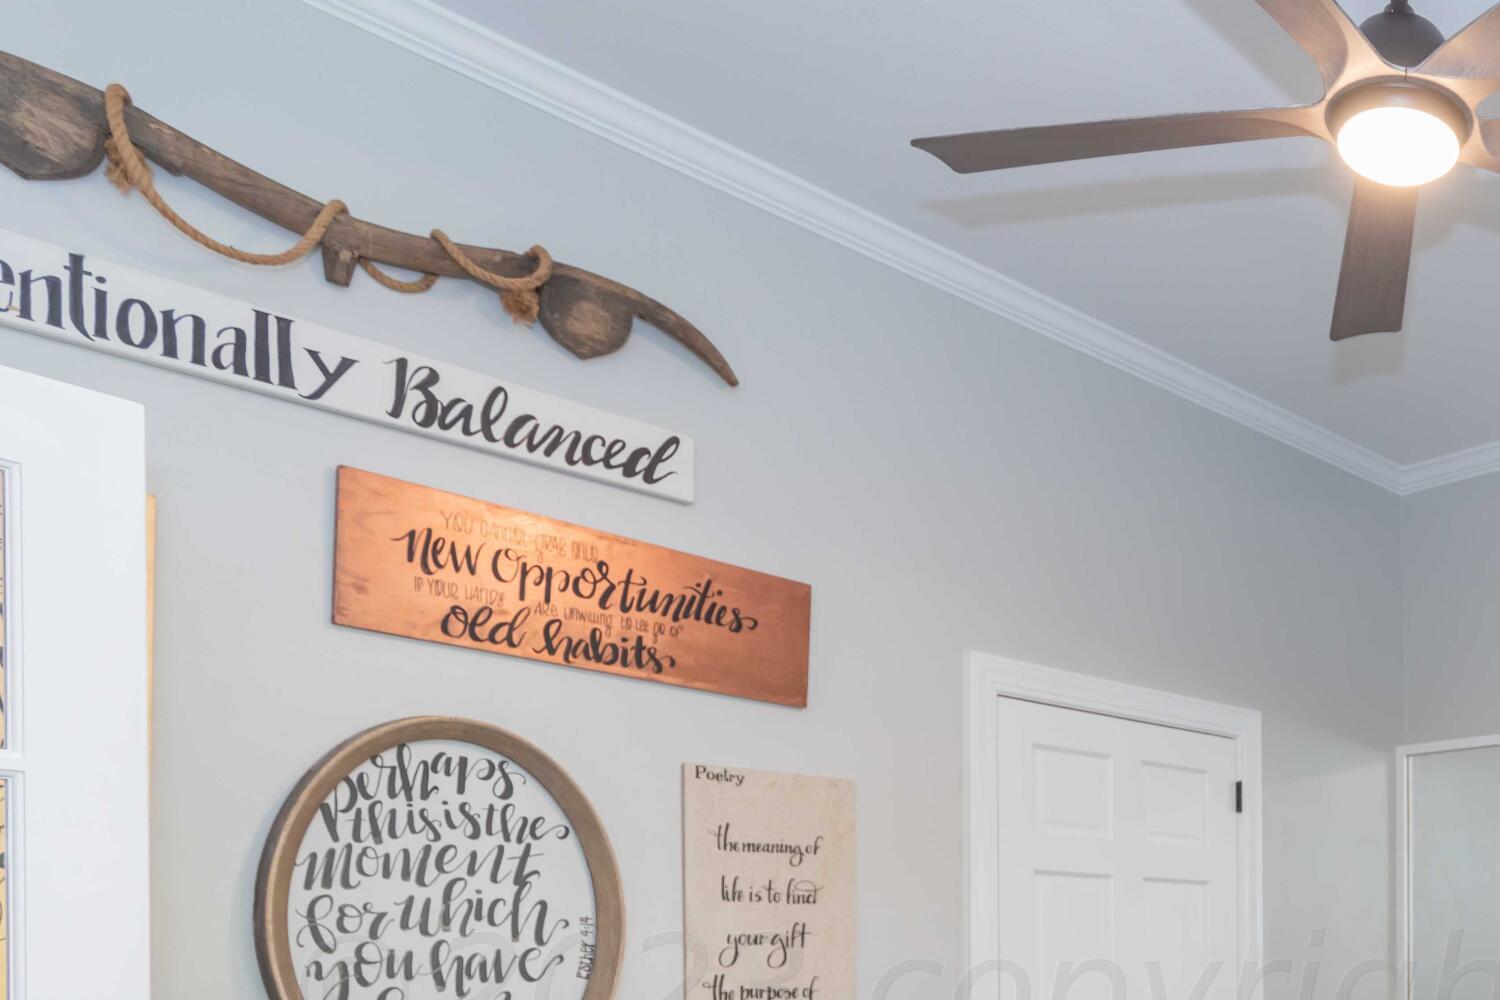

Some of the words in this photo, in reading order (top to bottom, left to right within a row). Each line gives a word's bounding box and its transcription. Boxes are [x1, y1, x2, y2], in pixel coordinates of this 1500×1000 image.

[382, 356, 681, 485] Balanced
[440, 510, 474, 535] YOU
[427, 577, 460, 601] YOUR
[695, 764, 745, 787] Poetry
[345, 800, 442, 845] this
[442, 799, 481, 840] is
[481, 802, 570, 844] the
[707, 822, 740, 853] the
[742, 838, 805, 868] meaning
[805, 835, 824, 856] of
[721, 874, 744, 902] life
[748, 886, 762, 903] is
[762, 879, 782, 904] to
[786, 877, 825, 905] find
[295, 894, 396, 955] for
[393, 876, 570, 947] which
[718, 933, 770, 969] your
[766, 922, 812, 969] gift
[422, 939, 565, 999] have
[801, 975, 822, 1000] of
